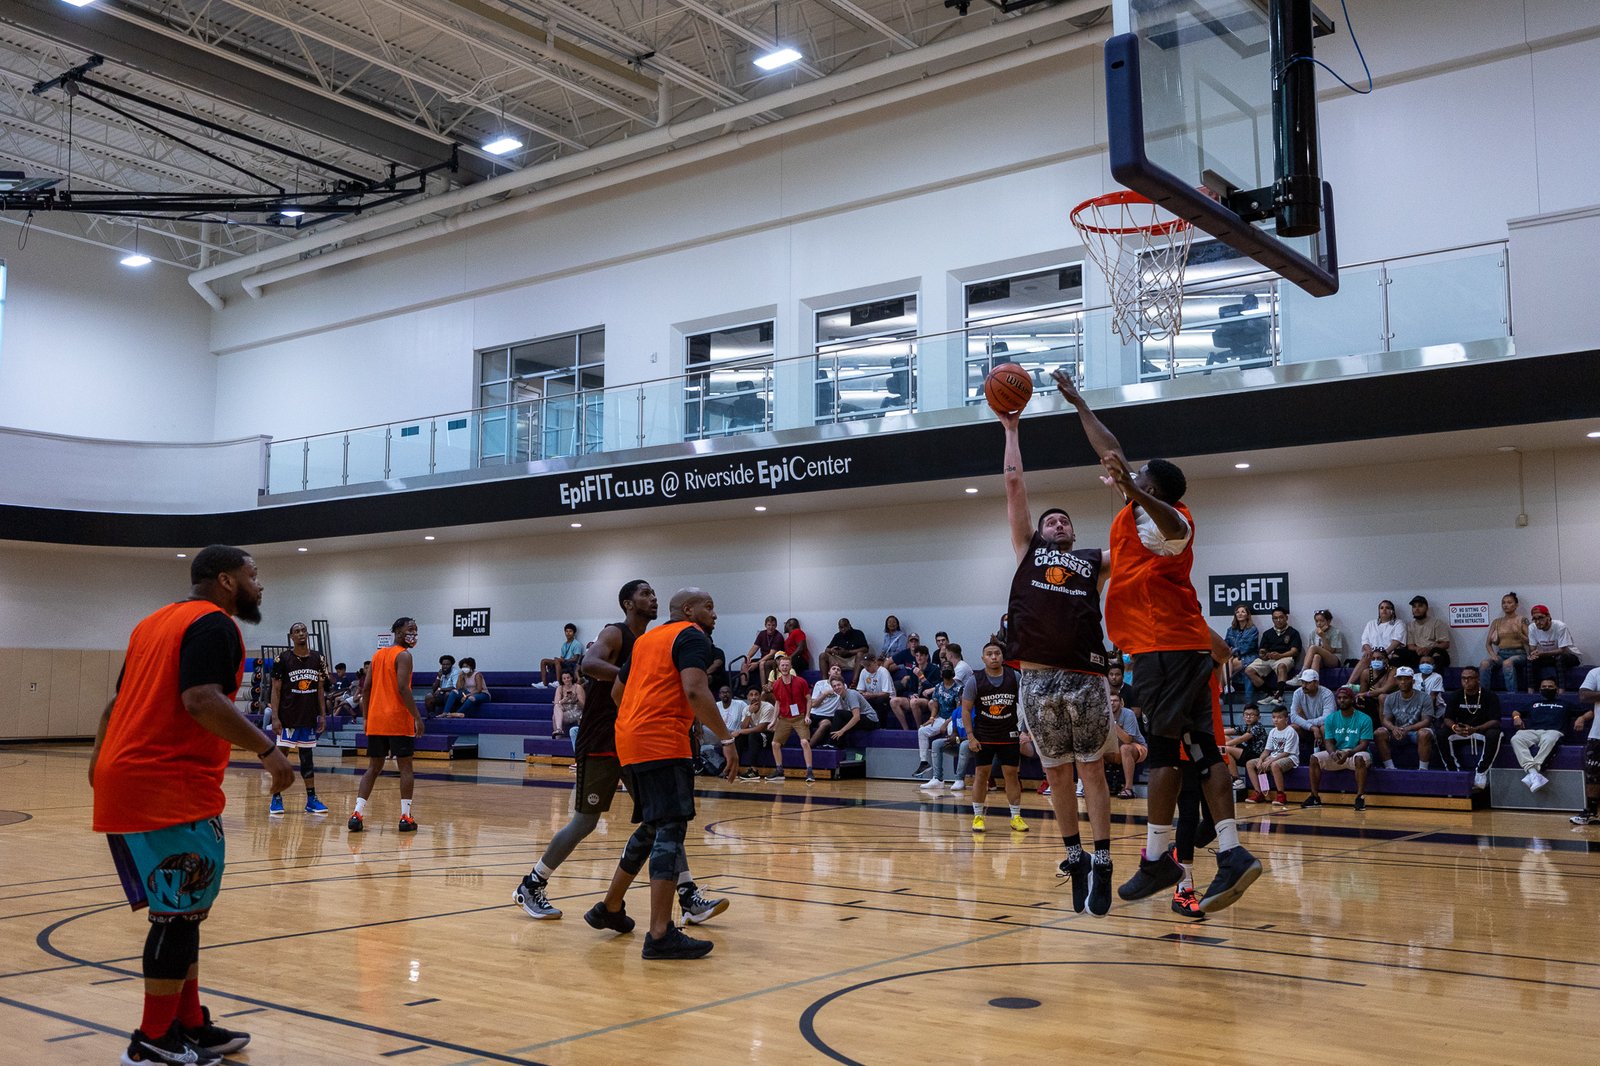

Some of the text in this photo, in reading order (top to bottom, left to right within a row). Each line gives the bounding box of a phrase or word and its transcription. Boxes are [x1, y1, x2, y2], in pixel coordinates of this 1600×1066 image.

[560, 455, 852, 509] EpiFIT CLUB @ Riverside EpiCenter
[1034, 555, 1092, 578] CLASSIC
[1031, 579, 1051, 591] TEAM
[1214, 577, 1283, 607] EpiFIT
[1253, 602, 1279, 611] CLUB
[455, 611, 488, 630] EpiFIT
[290, 674, 319, 682] CLASSIC
